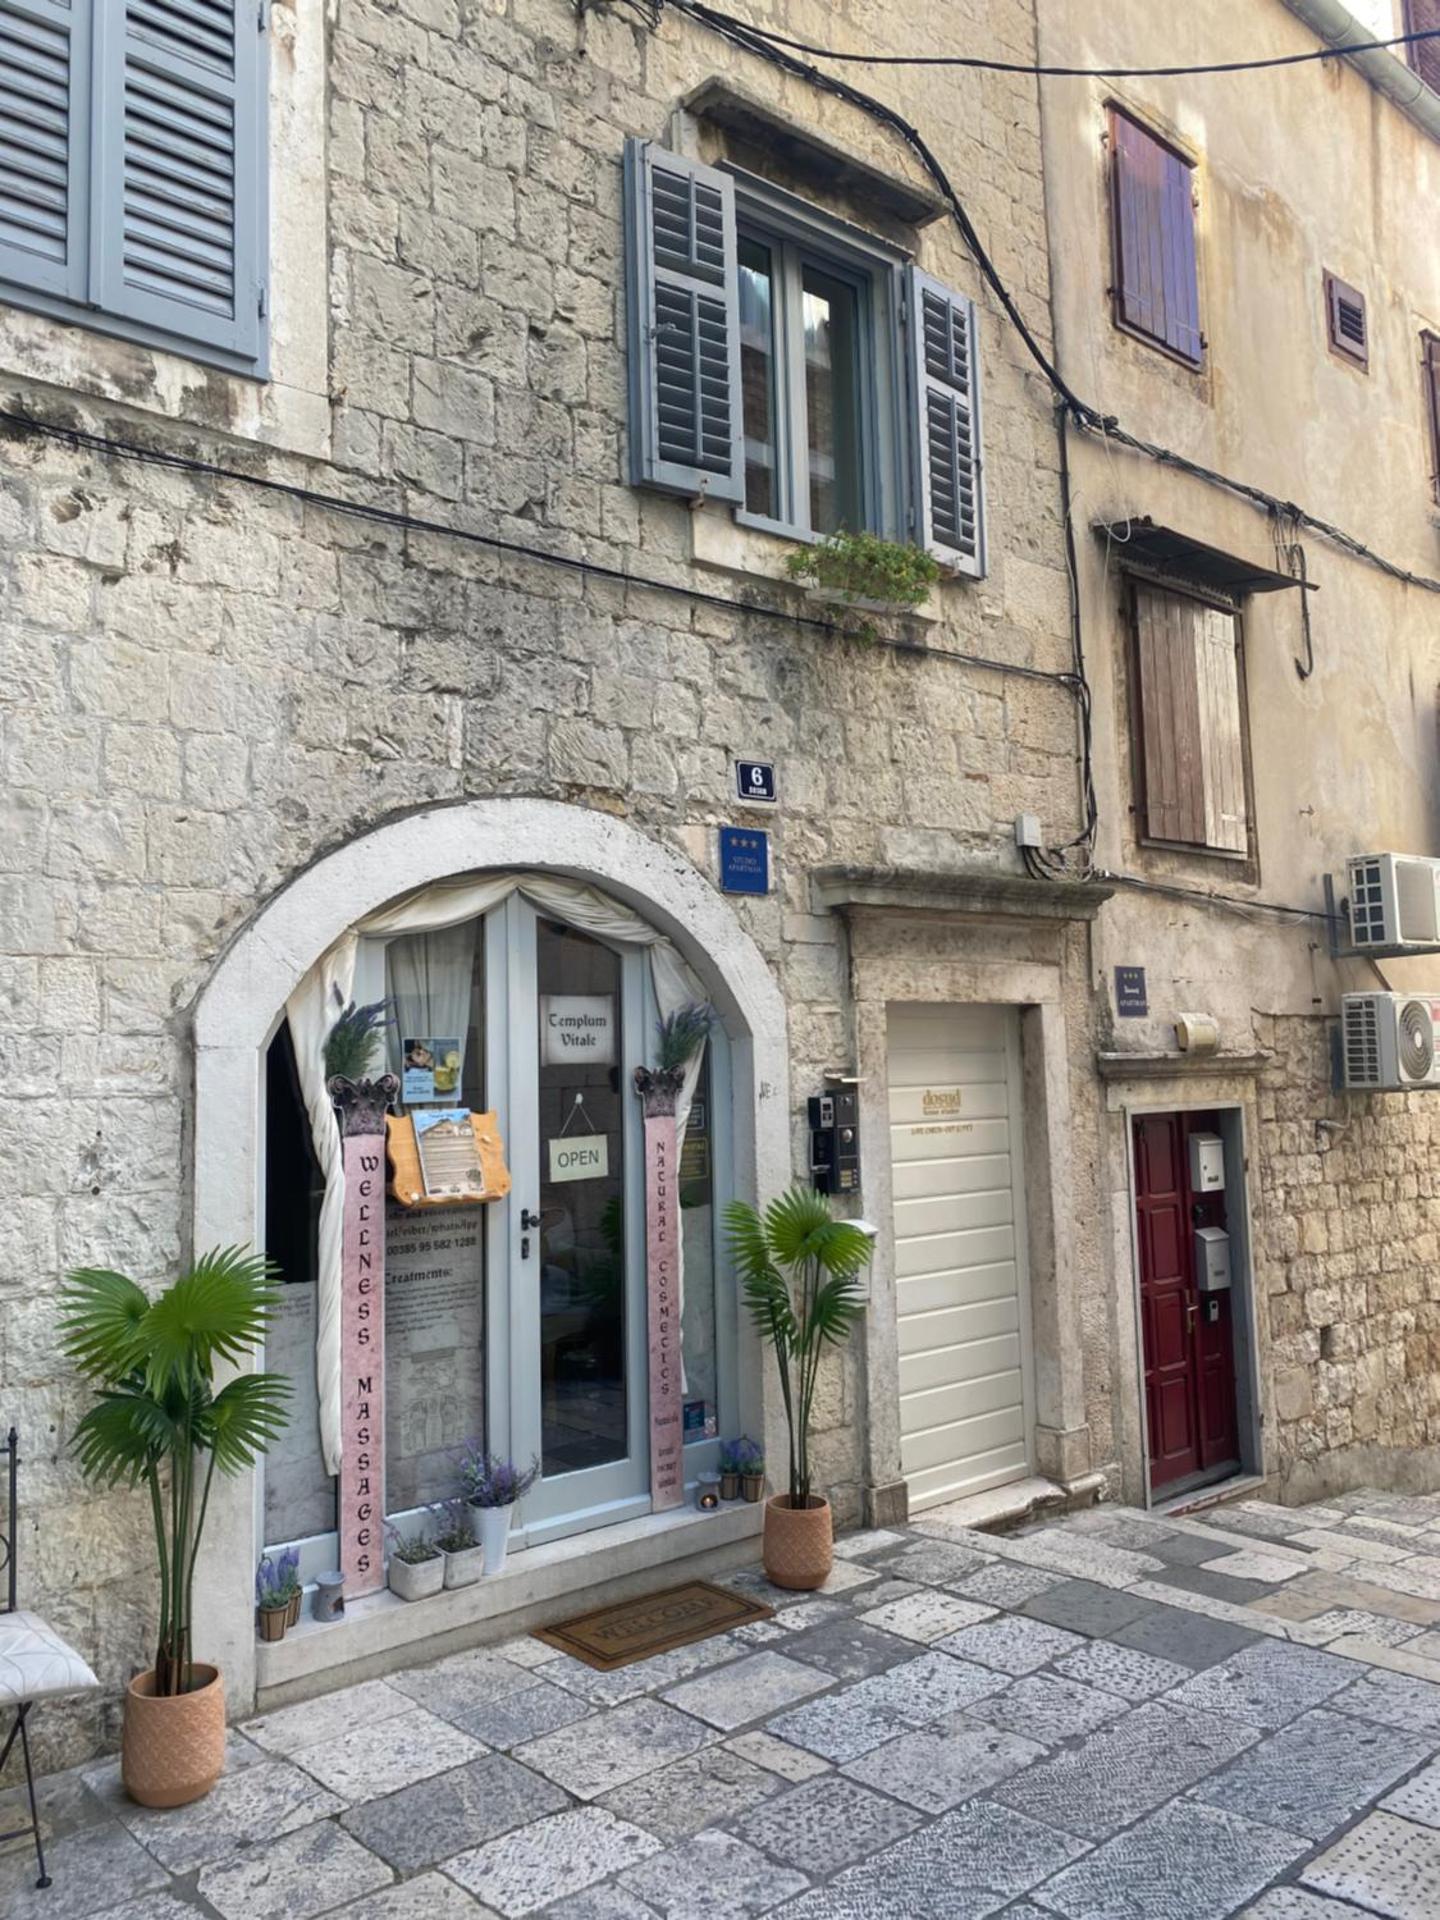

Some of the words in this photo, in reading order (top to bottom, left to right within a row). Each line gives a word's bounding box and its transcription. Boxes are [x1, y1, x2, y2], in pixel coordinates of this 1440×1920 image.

[751, 767, 763, 786] 6
[548, 1013, 607, 1030] Templum
[561, 1033, 597, 1046] Vitale
[557, 1150, 600, 1168] OPEN
[657, 1142, 667, 1242] NATURAL
[357, 1155, 379, 1345] WELLNESS
[658, 1260, 670, 1395] COSMETICS
[356, 1376, 374, 1573] MASSAGES
